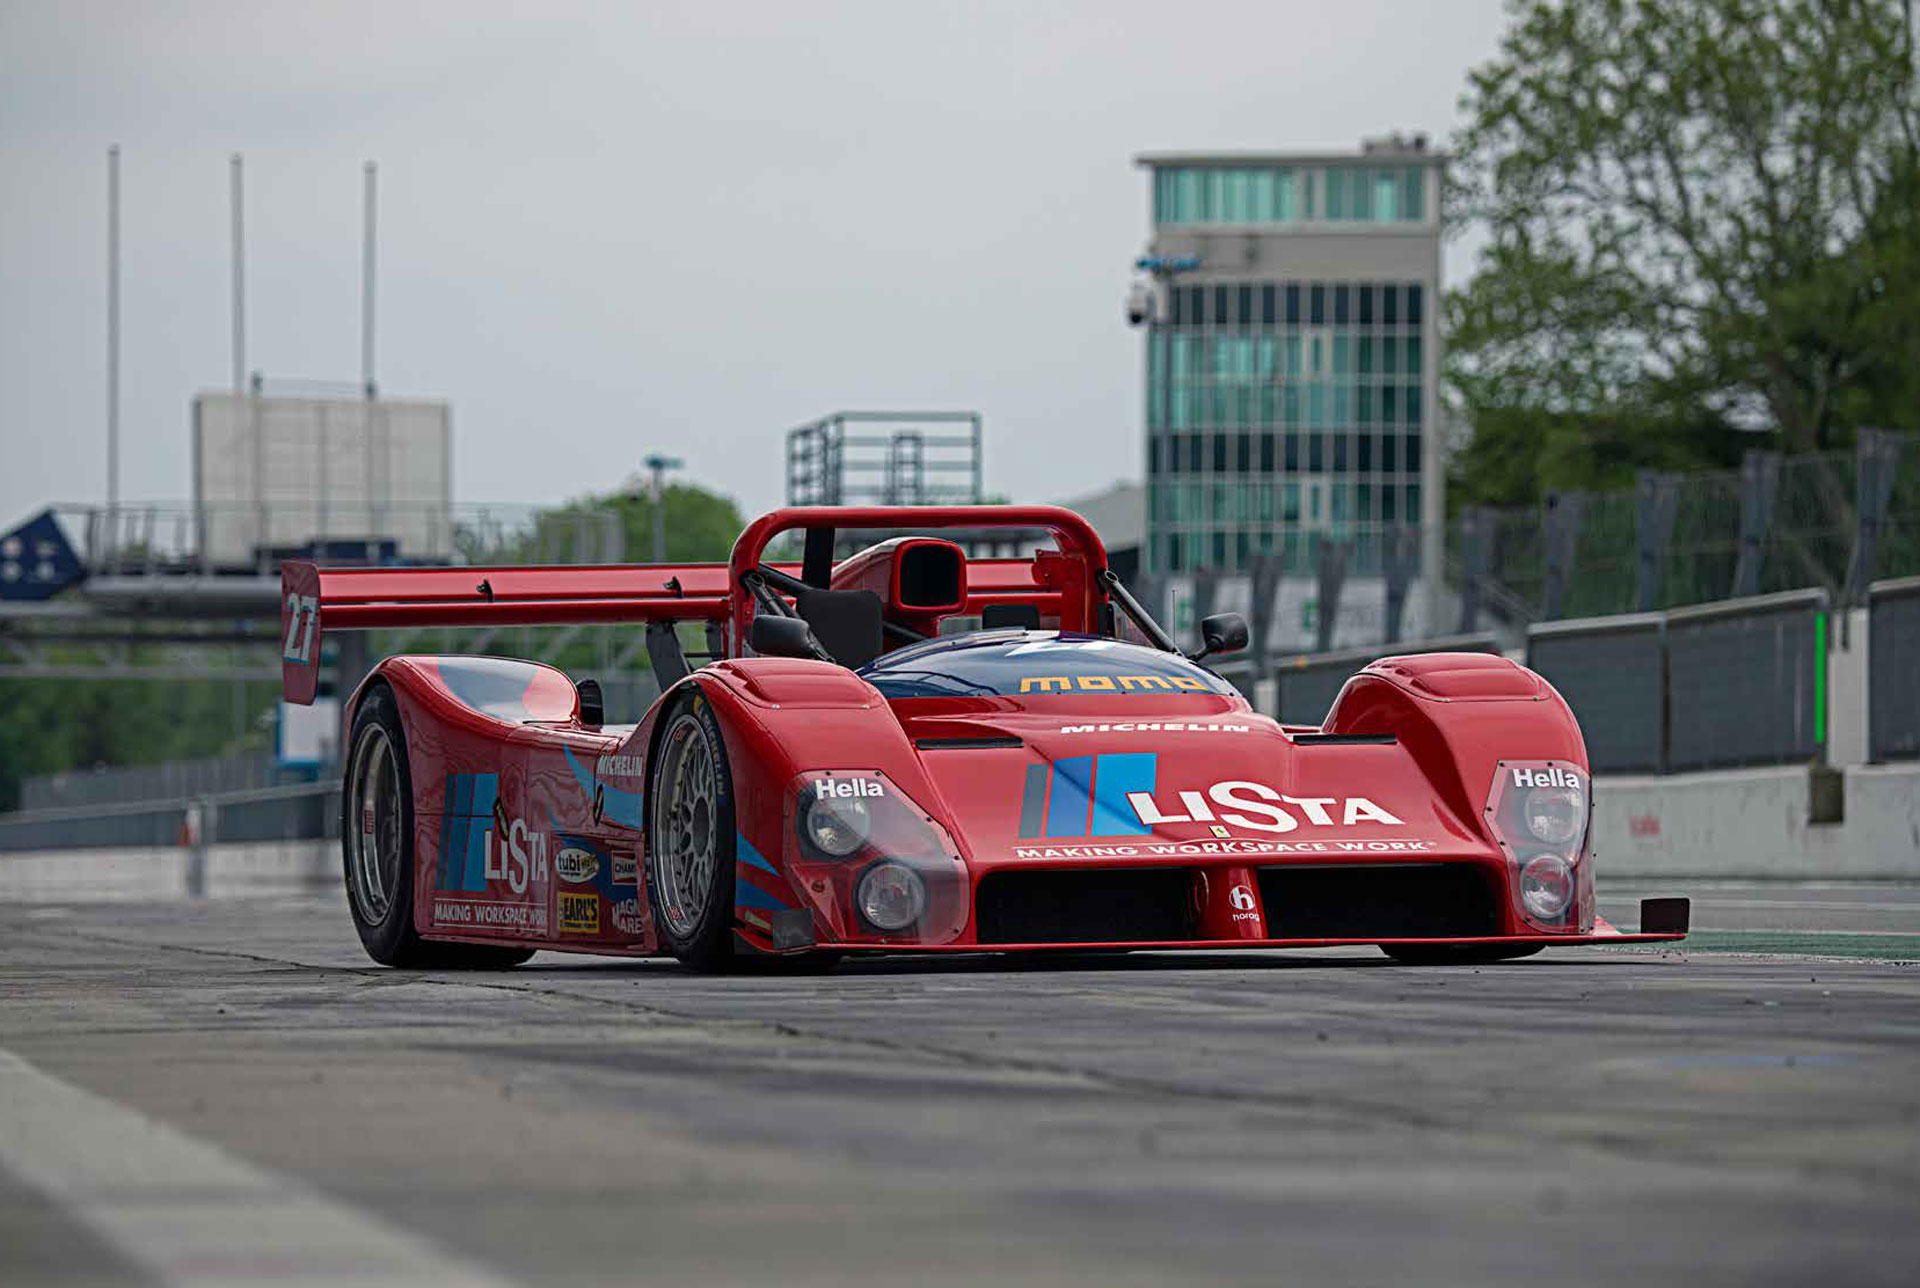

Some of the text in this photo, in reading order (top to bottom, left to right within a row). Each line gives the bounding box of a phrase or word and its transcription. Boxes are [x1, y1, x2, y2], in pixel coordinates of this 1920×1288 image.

[283, 593, 318, 666] 27
[1020, 676, 1210, 693] momo
[1060, 723, 1250, 734] MICHELIN
[597, 755, 643, 777] MICHELIN
[815, 778, 884, 799] Hella
[1513, 768, 1580, 789] Hella
[1127, 780, 1406, 833] LISTA
[1016, 846, 1138, 859] MAKING
[1147, 842, 1327, 856] WORKSPACE
[434, 902, 471, 921] MAKING
[475, 905, 527, 924] WORKSPACE
